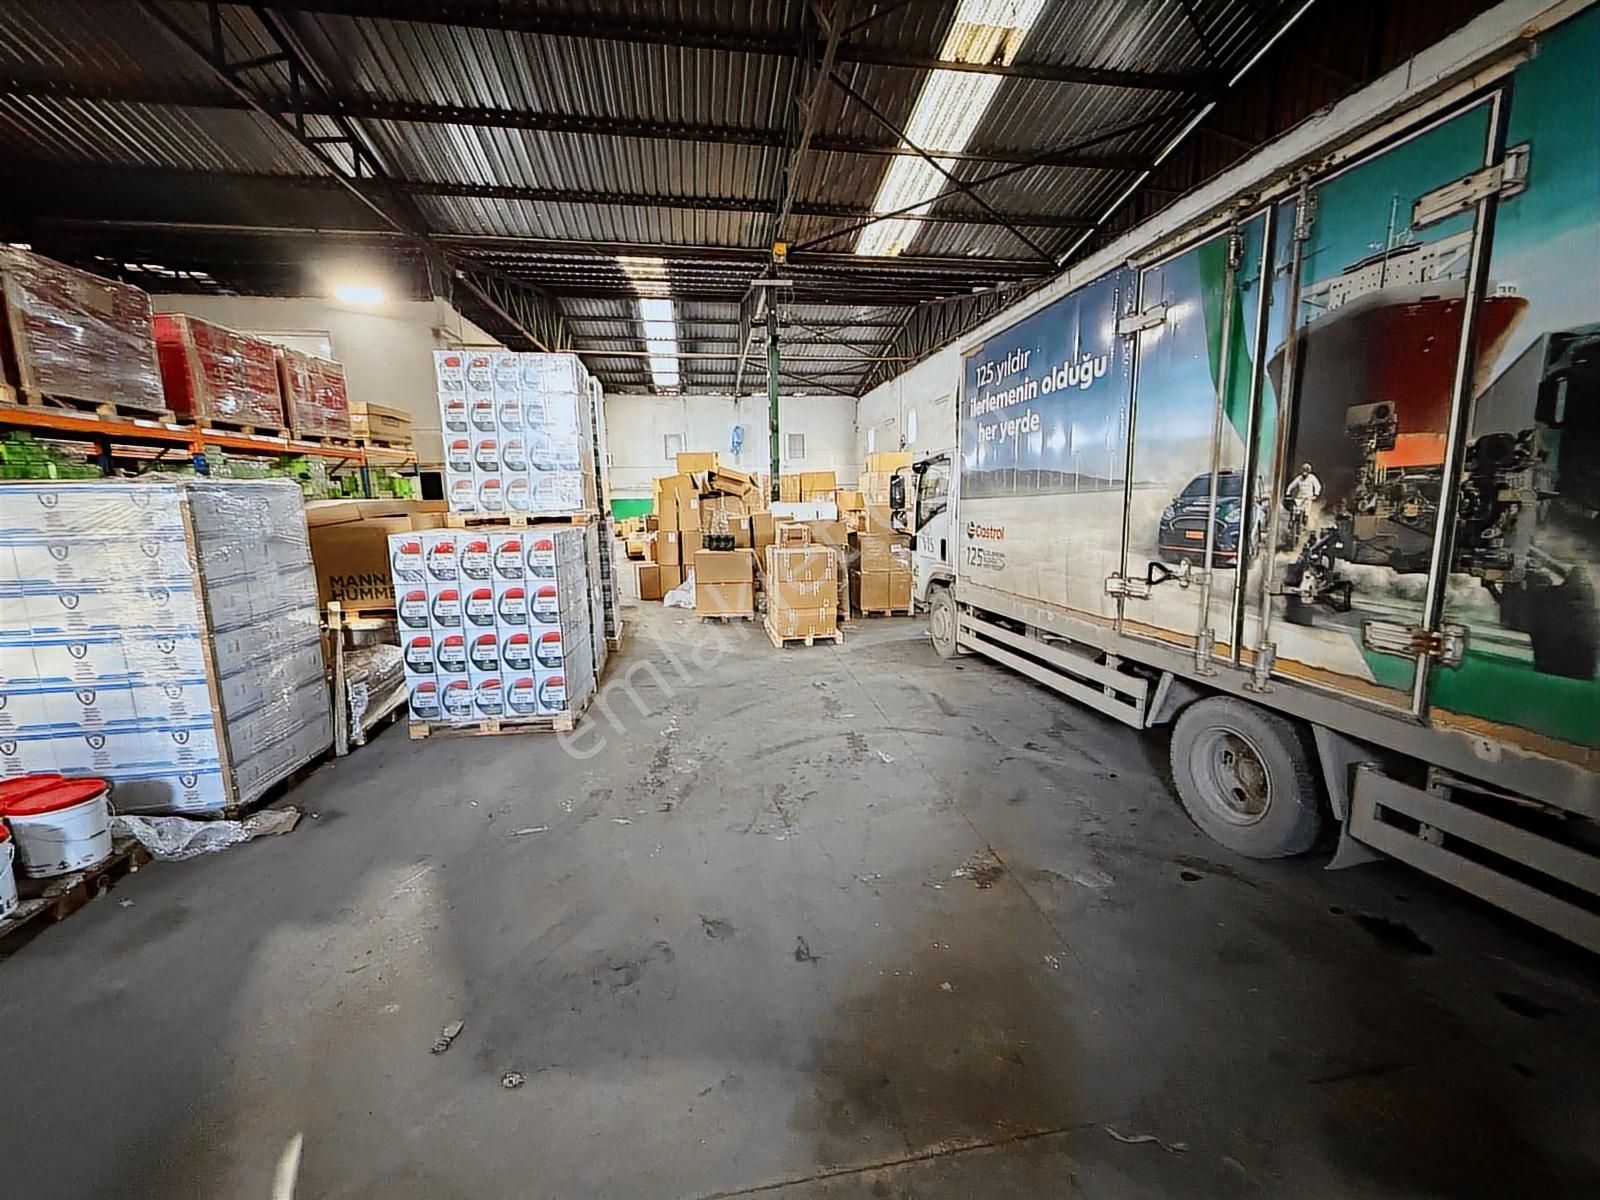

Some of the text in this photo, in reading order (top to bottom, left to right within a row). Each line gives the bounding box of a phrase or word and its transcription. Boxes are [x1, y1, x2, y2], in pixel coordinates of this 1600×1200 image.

[976, 347, 1031, 388] 125 yıldır
[969, 352, 1107, 418] ilerlemenin olduğu
[978, 407, 1040, 445] her yerde
[976, 524, 1005, 540] Castrol
[967, 546, 982, 567] 125
[329, 573, 387, 588] MANN
